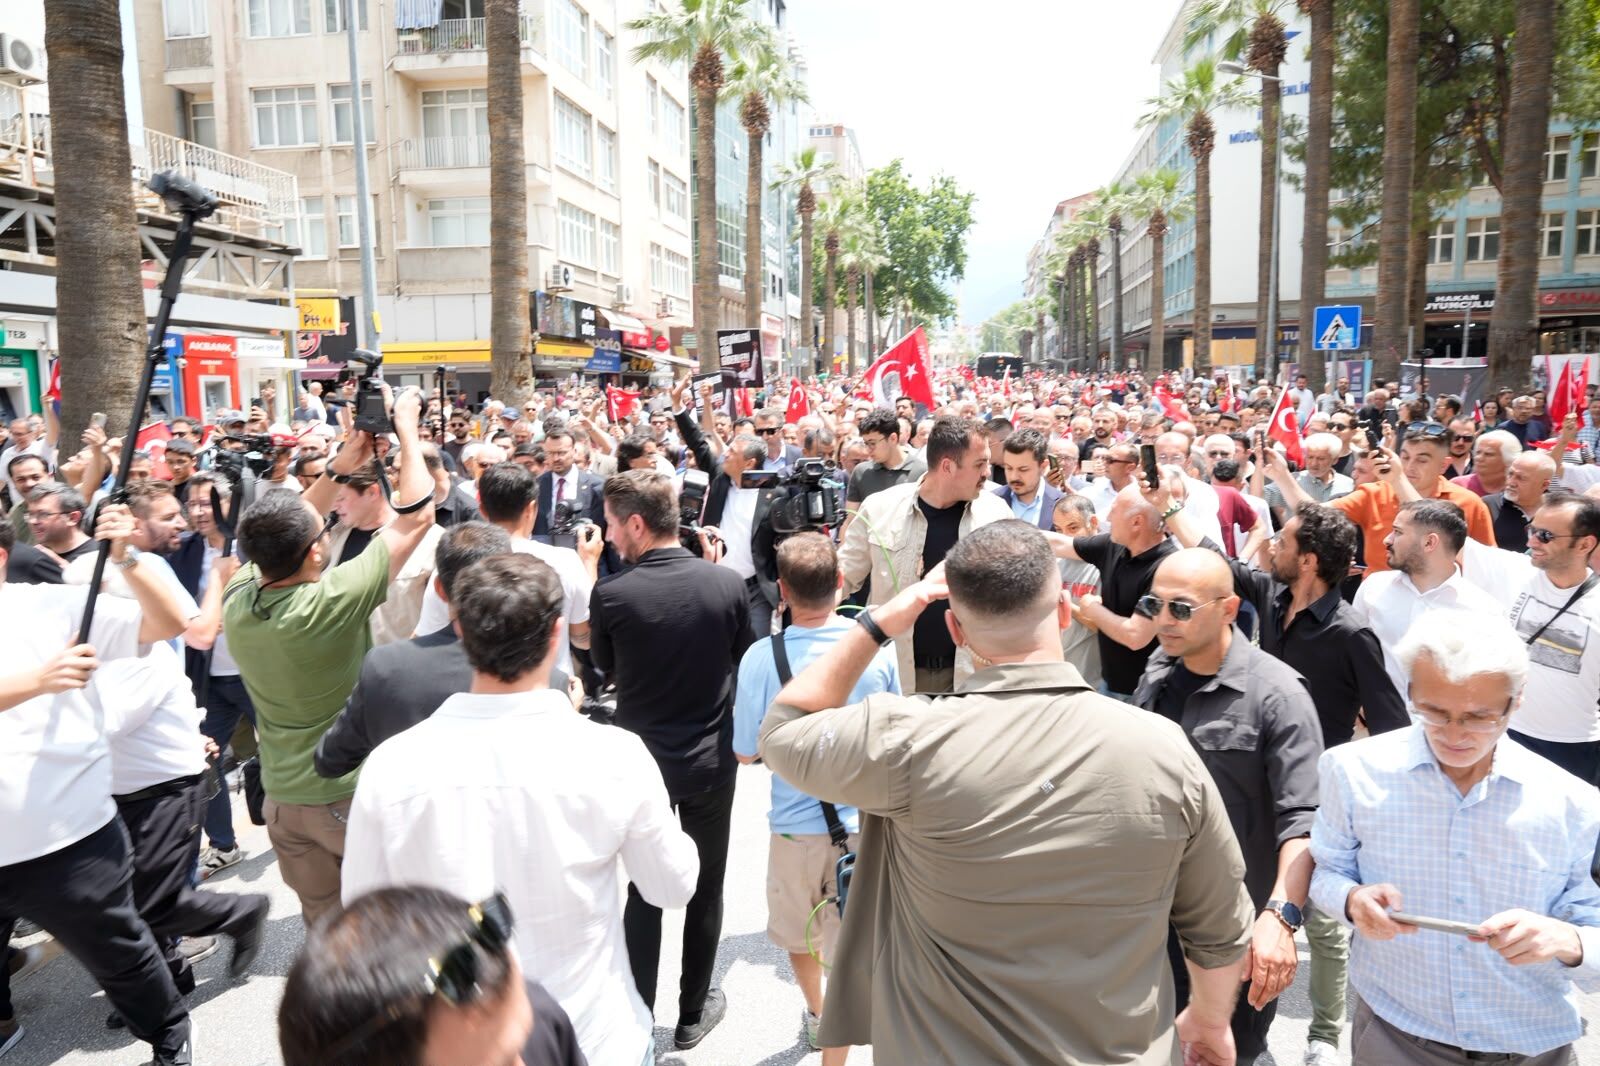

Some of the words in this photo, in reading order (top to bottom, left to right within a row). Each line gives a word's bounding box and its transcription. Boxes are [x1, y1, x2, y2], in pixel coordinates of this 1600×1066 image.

[1434, 294, 1480, 302] HAKAN
[8, 330, 27, 339] TEB
[1283, 330, 1299, 341] TU
[189, 341, 233, 353] AKBANK
